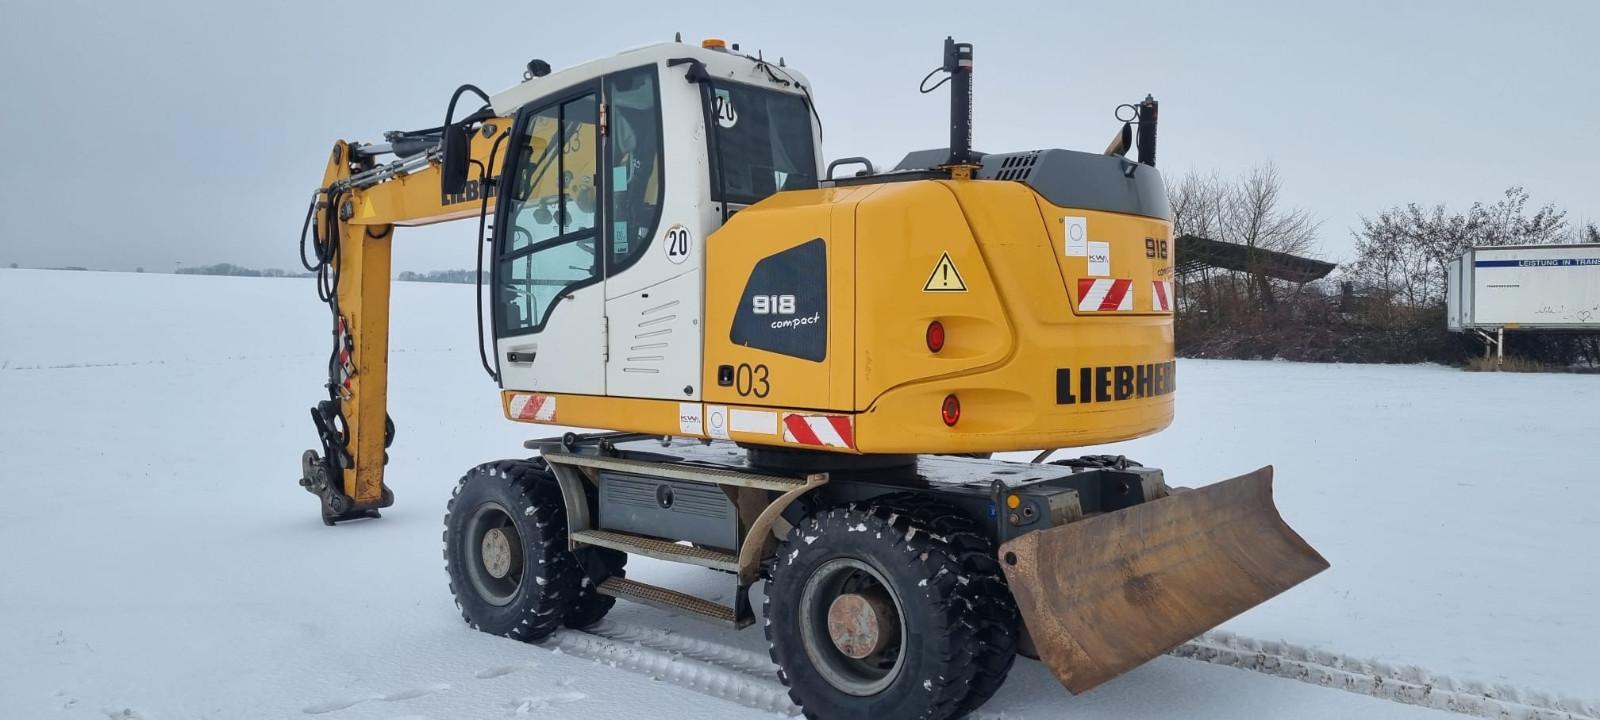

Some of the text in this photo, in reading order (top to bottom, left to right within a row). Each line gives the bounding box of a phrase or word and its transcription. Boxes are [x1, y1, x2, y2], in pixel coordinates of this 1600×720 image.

[669, 230, 688, 256] 20
[1145, 237, 1168, 260] 918
[752, 294, 796, 314] 918
[771, 312, 820, 329] compact
[736, 363, 770, 398] 03
